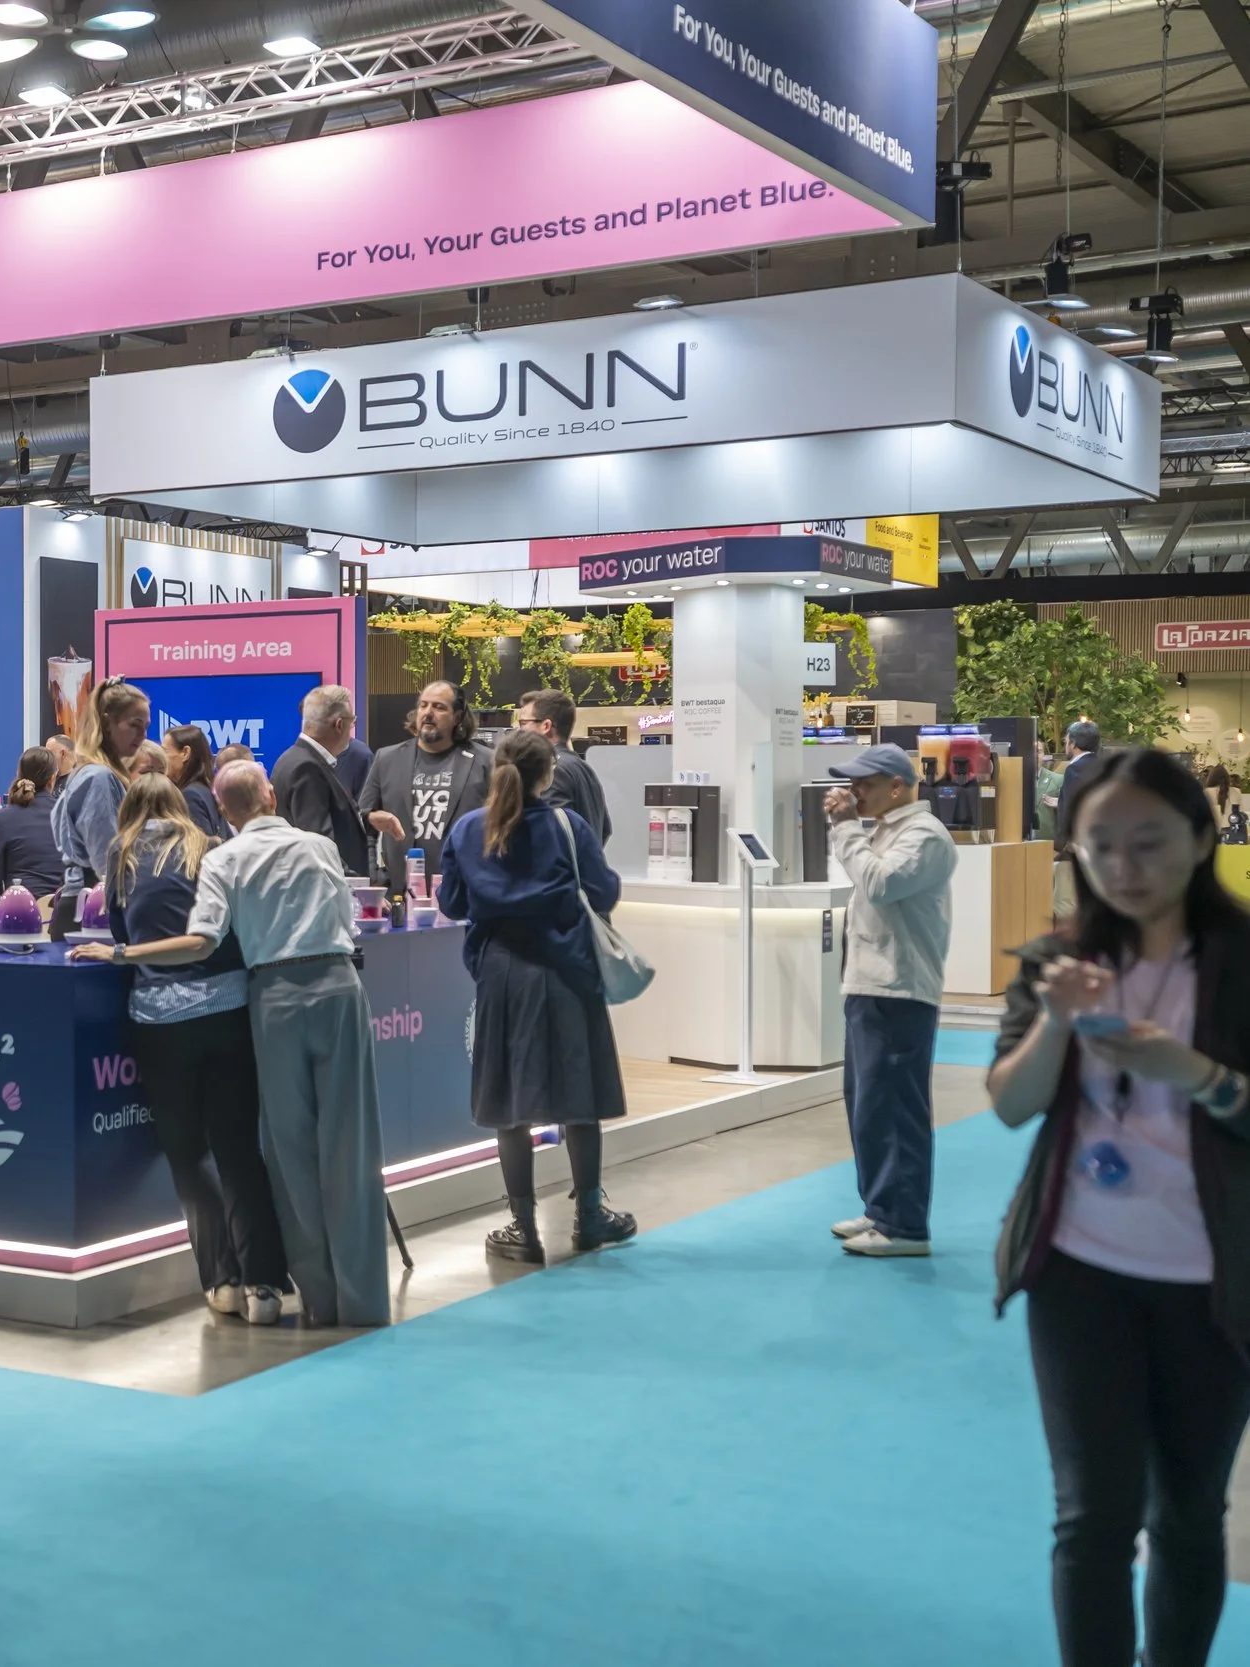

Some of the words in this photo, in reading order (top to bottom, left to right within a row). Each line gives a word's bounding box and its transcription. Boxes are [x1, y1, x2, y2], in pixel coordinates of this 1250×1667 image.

[674, 4, 702, 44] For
[704, 22, 736, 70] You,
[738, 43, 772, 88] Your
[773, 67, 820, 117] Guests
[822, 100, 847, 133] and
[848, 112, 886, 157] Planet
[887, 136, 914, 174] Blue.
[317, 250, 356, 270] For
[364, 242, 416, 264] You,
[424, 231, 484, 256] Your
[490, 215, 586, 246] Guests
[594, 203, 647, 232] and
[657, 187, 751, 223] Planet
[760, 180, 835, 207] Blue.
[1037, 350, 1124, 443] BUNN
[419, 431, 489, 450] Quality
[494, 425, 550, 442] Since
[557, 419, 615, 436] 1840
[1054, 426, 1076, 446] Quality
[581, 558, 618, 581] ROC
[622, 554, 662, 580] your
[666, 545, 722, 570] water
[822, 543, 842, 565] ROC
[844, 549, 865, 570] your
[150, 640, 236, 663] Training
[242, 640, 292, 658] Area
[806, 657, 831, 672] H23
[190, 718, 264, 749] BWT
[413, 805, 447, 823] UT
[413, 821, 445, 840] ON
[371, 1003, 423, 1042] nship
[92, 1054, 140, 1090] Wo
